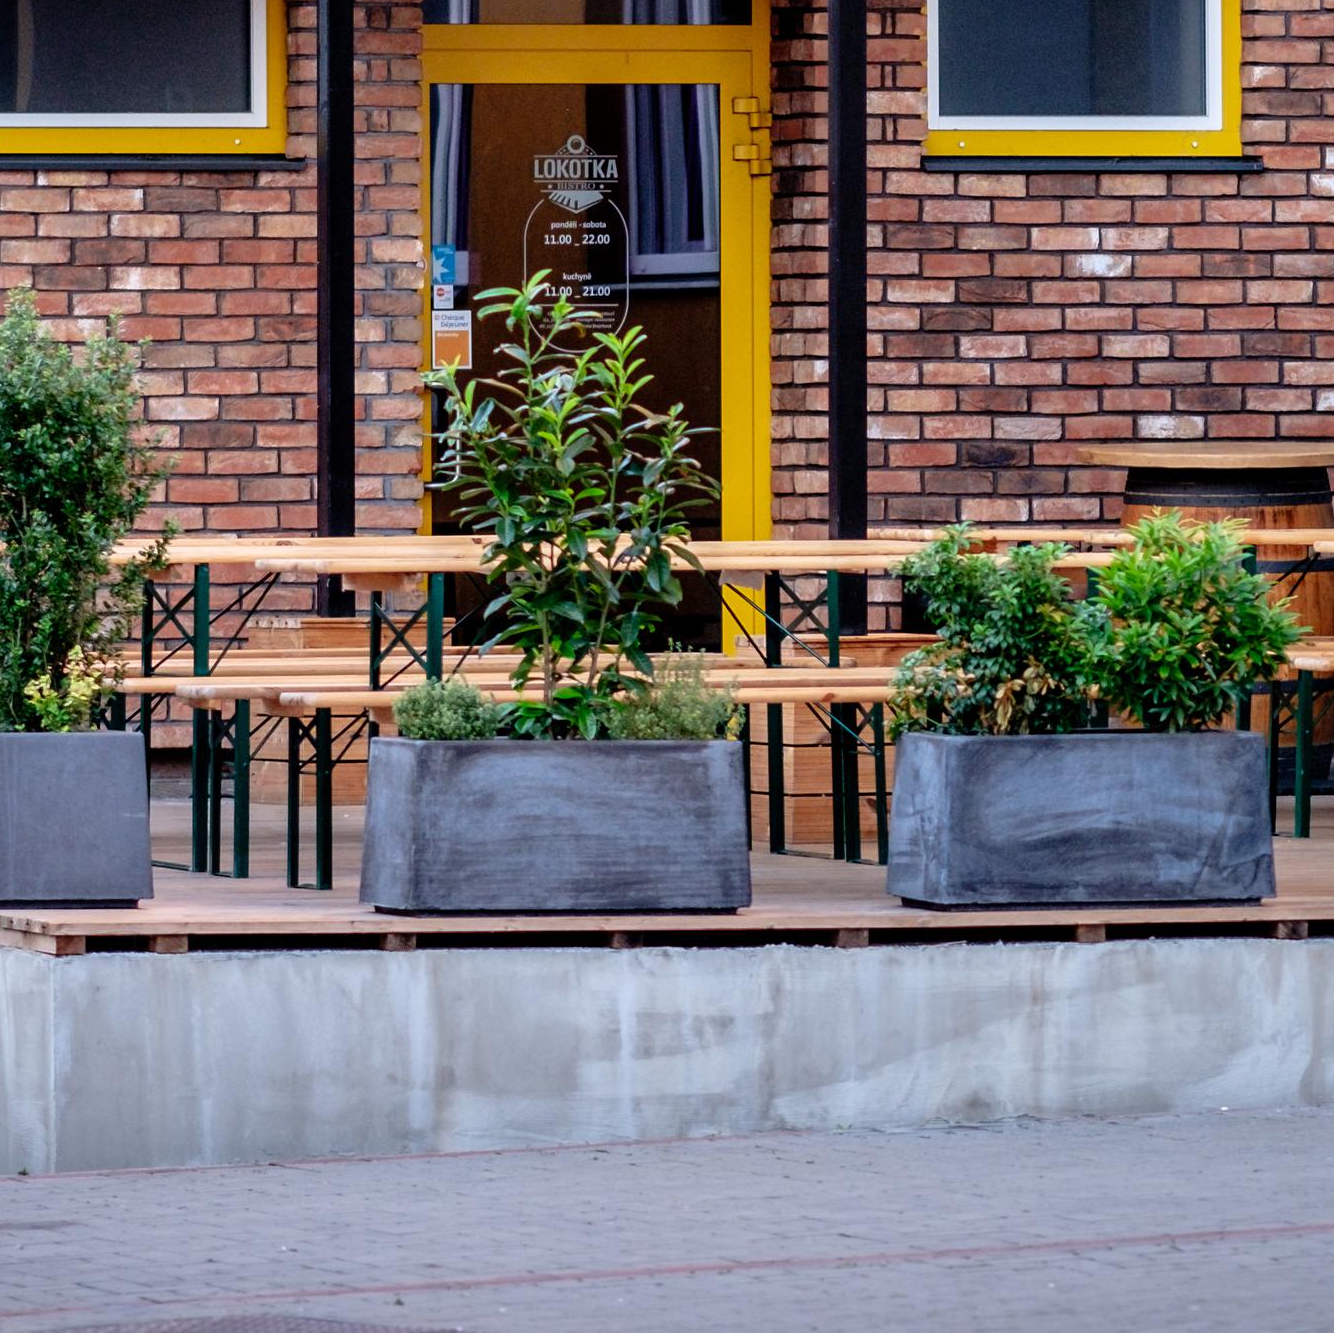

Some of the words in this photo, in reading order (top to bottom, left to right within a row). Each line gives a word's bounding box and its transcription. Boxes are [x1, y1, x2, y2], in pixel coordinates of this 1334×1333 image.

[534, 158, 619, 179] LOKOTKA
[557, 182, 596, 190] BISTRO
[550, 220, 577, 230] pondělí
[582, 220, 607, 229] sobota
[544, 234, 572, 245] 11.00
[582, 234, 610, 245] 22.00
[562, 272, 592, 282] kuchyně
[545, 286, 572, 297] 11.00
[582, 286, 611, 297] 21.00
